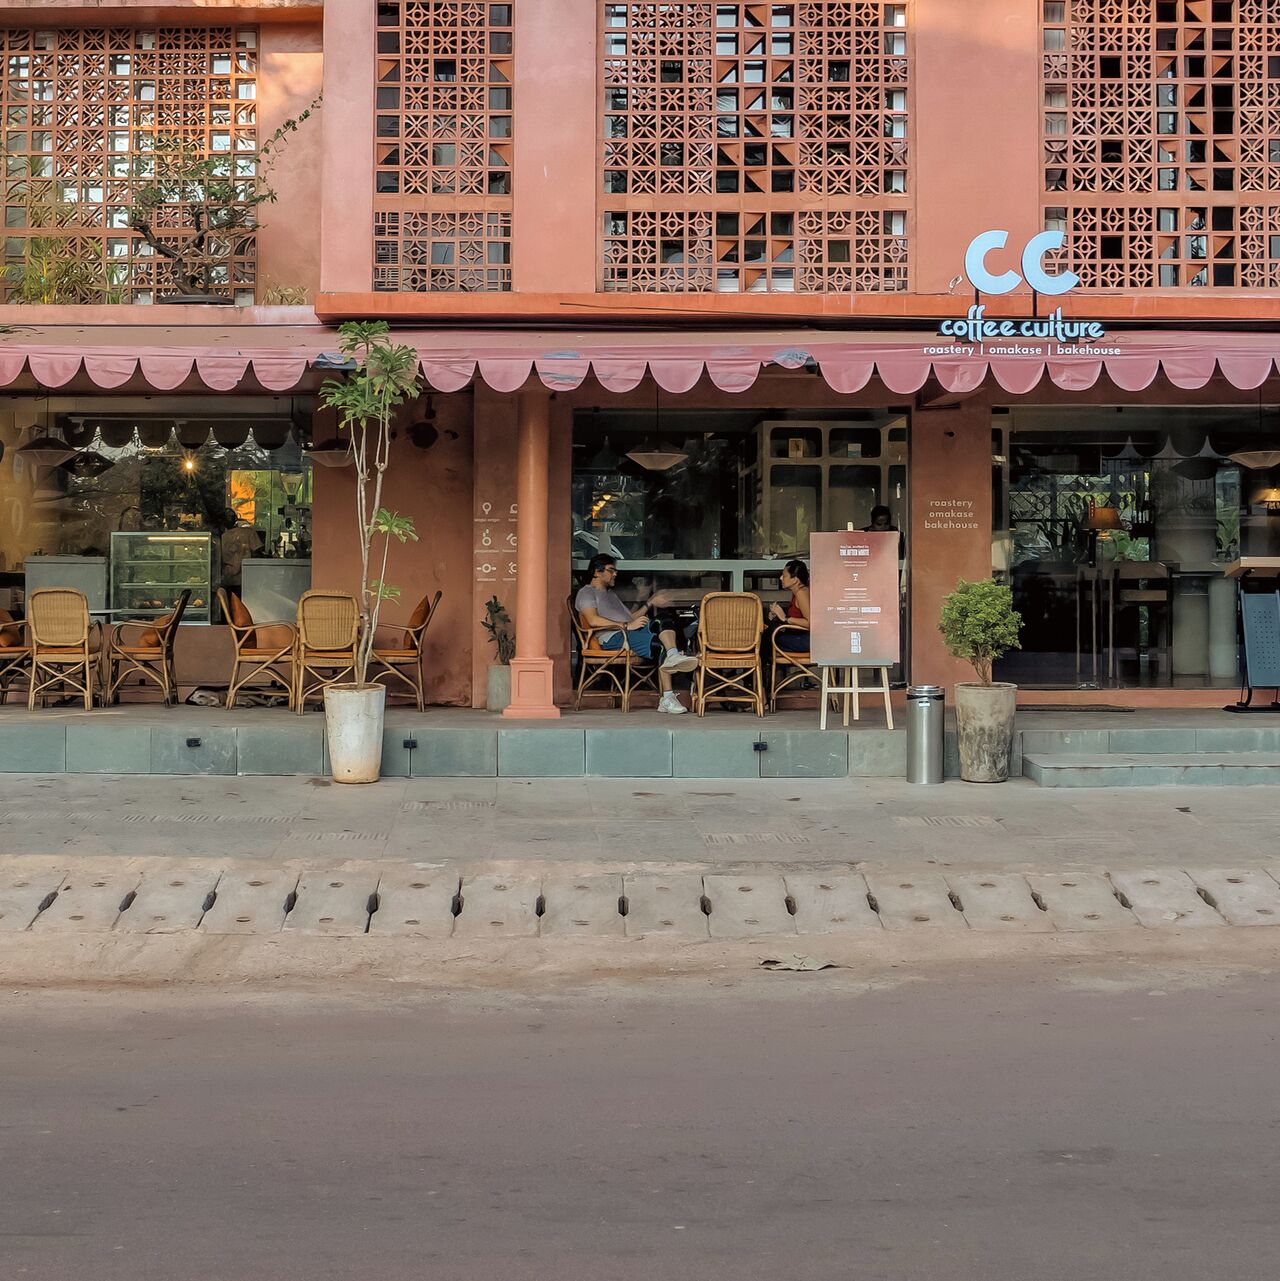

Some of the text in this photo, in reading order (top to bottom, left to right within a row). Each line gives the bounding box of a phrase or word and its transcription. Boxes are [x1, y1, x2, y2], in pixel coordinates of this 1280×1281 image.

[939, 304, 1105, 342] coffee culture
[923, 343, 1121, 356] roastery omakase bakehouse
[930, 500, 973, 508] roastery
[929, 509, 974, 518] omakase
[924, 520, 979, 529] bakehouse
